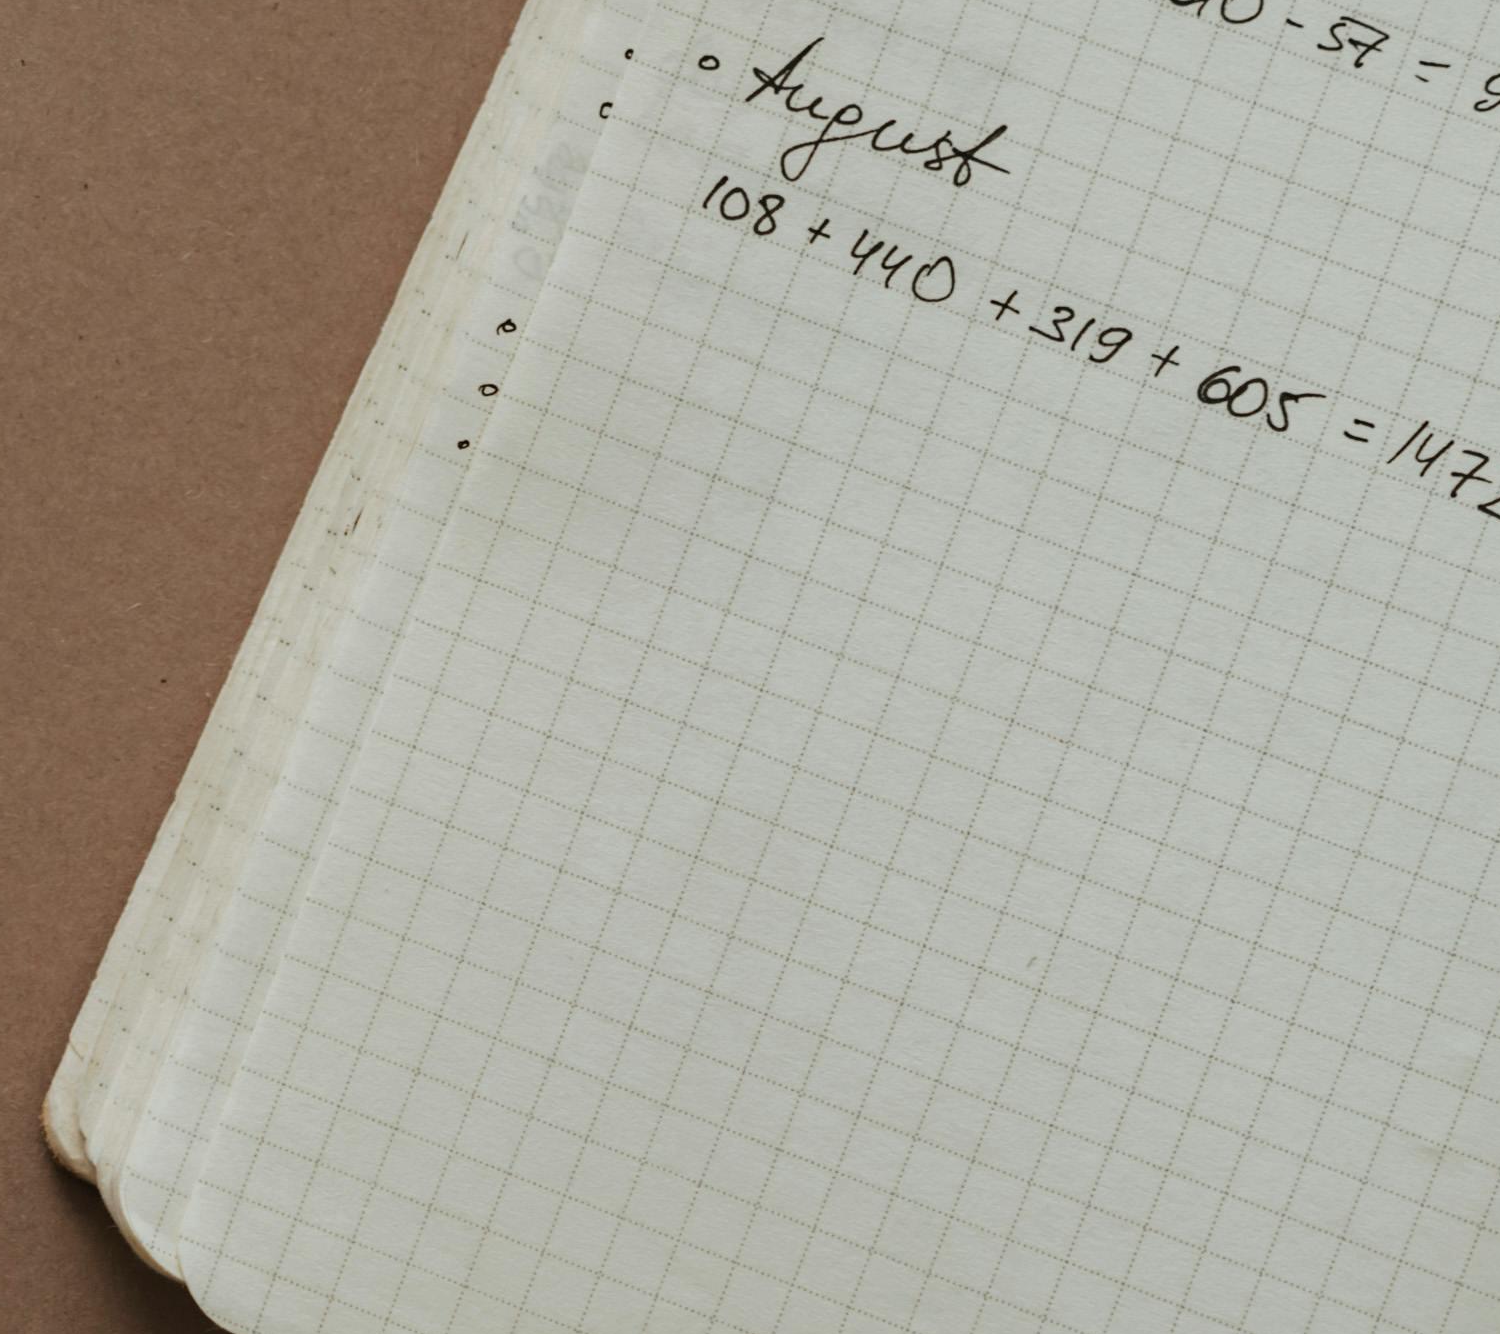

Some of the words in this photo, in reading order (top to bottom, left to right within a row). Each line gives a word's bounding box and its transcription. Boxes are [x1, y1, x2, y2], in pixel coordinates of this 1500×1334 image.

[746, 37, 1010, 186] August
[702, 175, 785, 236] 108
[850, 230, 955, 302] 440
[1028, 306, 1132, 363] 319
[1197, 365, 1327, 432] 605
